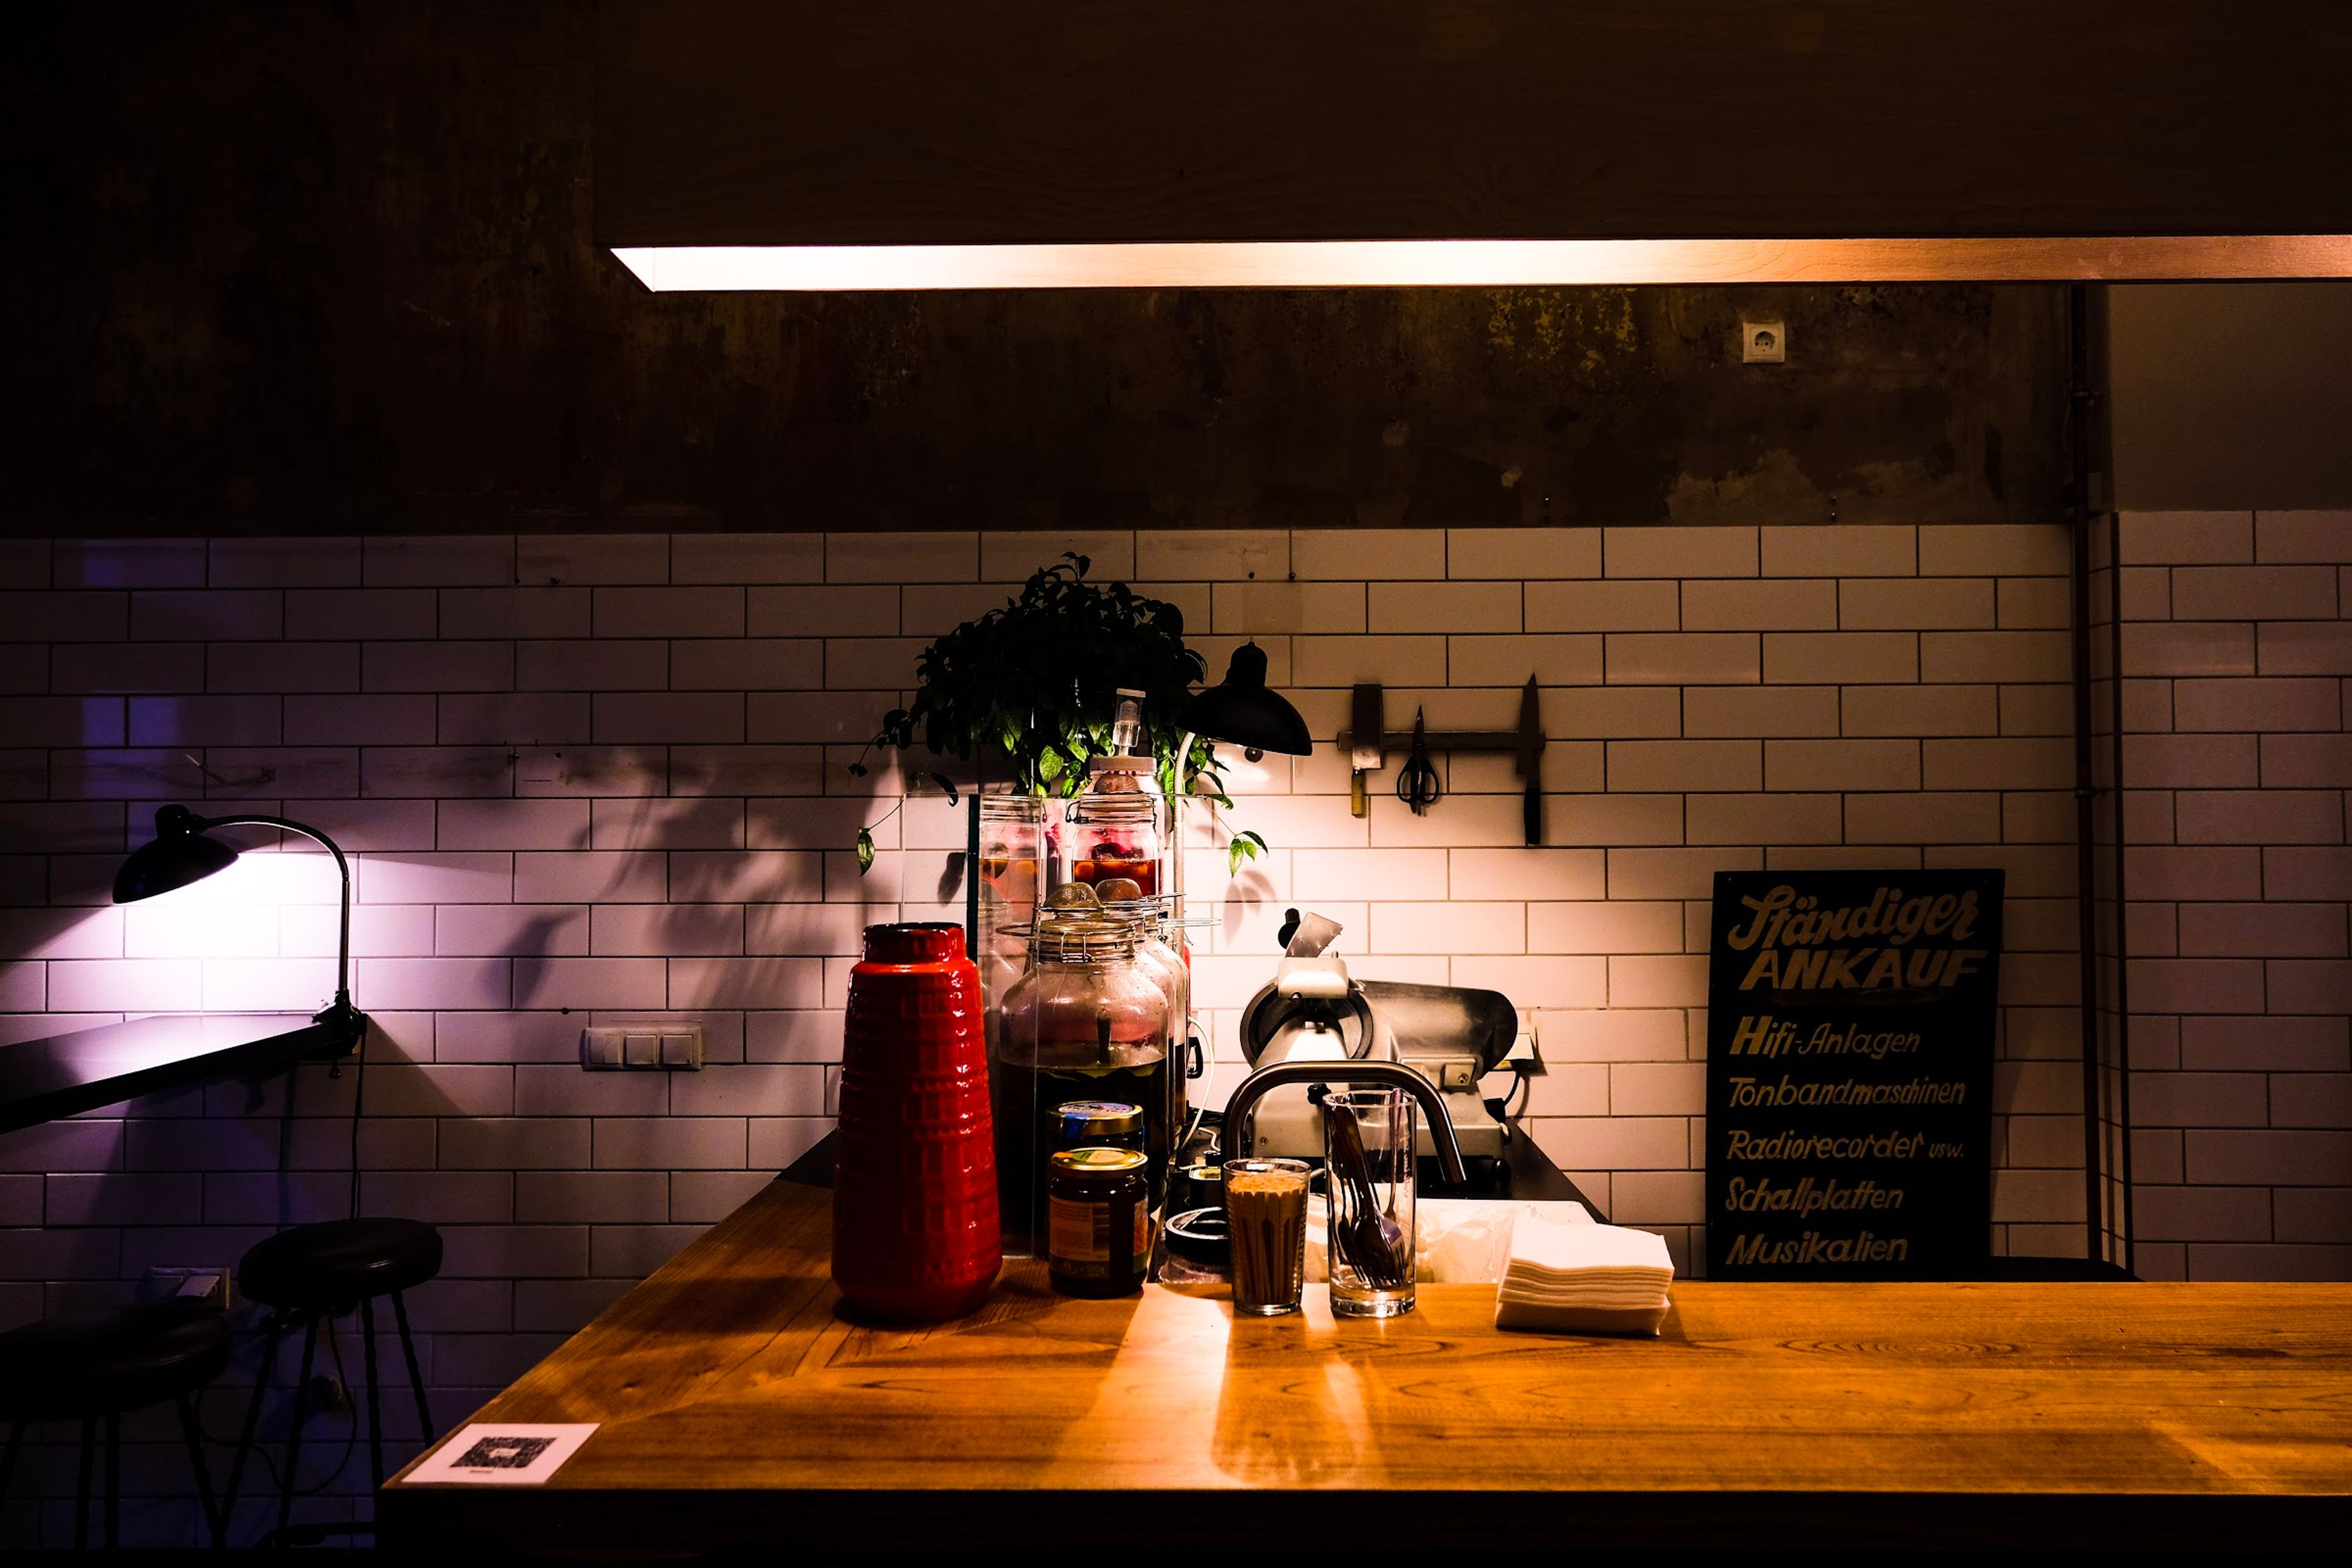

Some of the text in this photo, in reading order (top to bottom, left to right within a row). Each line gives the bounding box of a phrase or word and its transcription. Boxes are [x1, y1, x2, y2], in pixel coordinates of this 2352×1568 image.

[1727, 884, 1981, 951] Ständiger
[1738, 948, 1989, 991] ANKAUF
[1729, 1016, 1921, 1060] Hifi-Anlagen
[1729, 1074, 1967, 1107] Tonbandmaschinen
[1726, 1128, 1964, 1160] Radiorecorder usw.
[1725, 1177, 1904, 1219] Schallplatten
[1725, 1230, 1909, 1265] Musikalien
